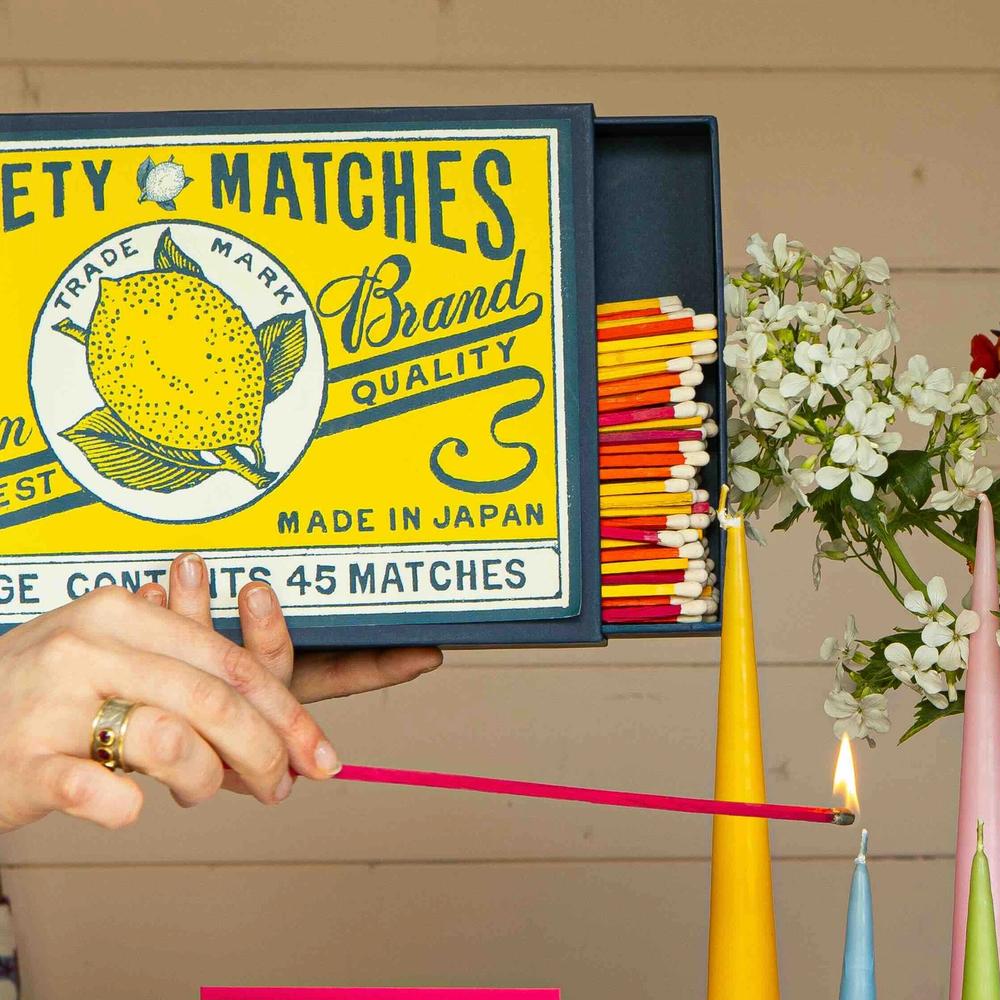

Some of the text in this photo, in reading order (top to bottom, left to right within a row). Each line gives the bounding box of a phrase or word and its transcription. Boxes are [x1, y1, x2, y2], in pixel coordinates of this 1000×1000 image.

[210, 148, 516, 261] MATCHES
[54, 237, 295, 311] TRADE MARK
[316, 249, 537, 354] Brand
[351, 336, 518, 405] QUALITY
[277, 503, 545, 534] MADE IN JAPAN
[286, 564, 337, 595] 45
[349, 558, 527, 594] MATCHES
